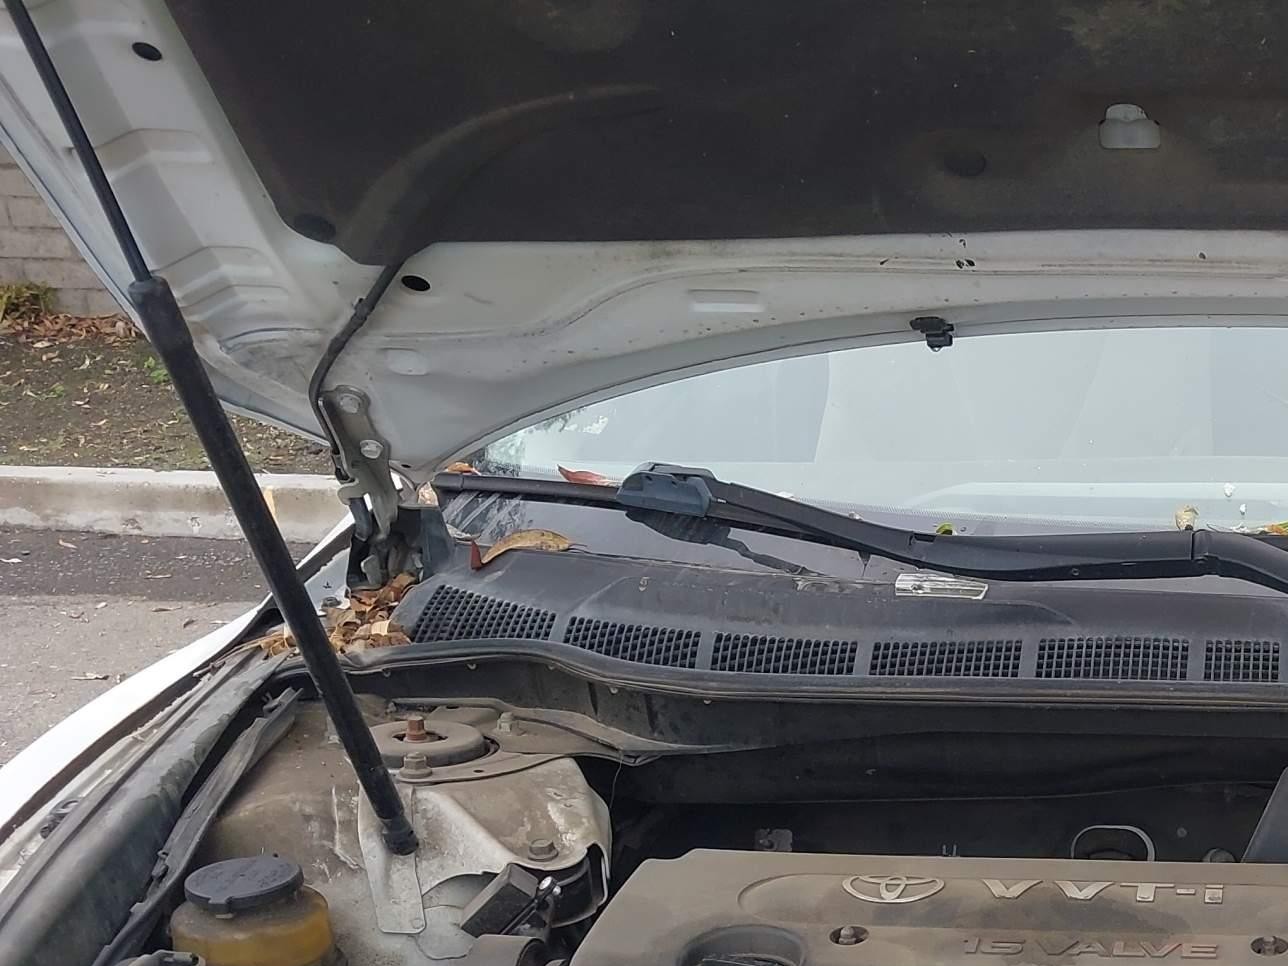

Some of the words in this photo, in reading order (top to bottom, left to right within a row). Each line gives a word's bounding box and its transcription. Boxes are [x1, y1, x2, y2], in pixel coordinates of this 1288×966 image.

[981, 879, 1224, 904] VVT-i
[963, 937, 1026, 955] 16
[1034, 938, 1218, 959] VALVE
